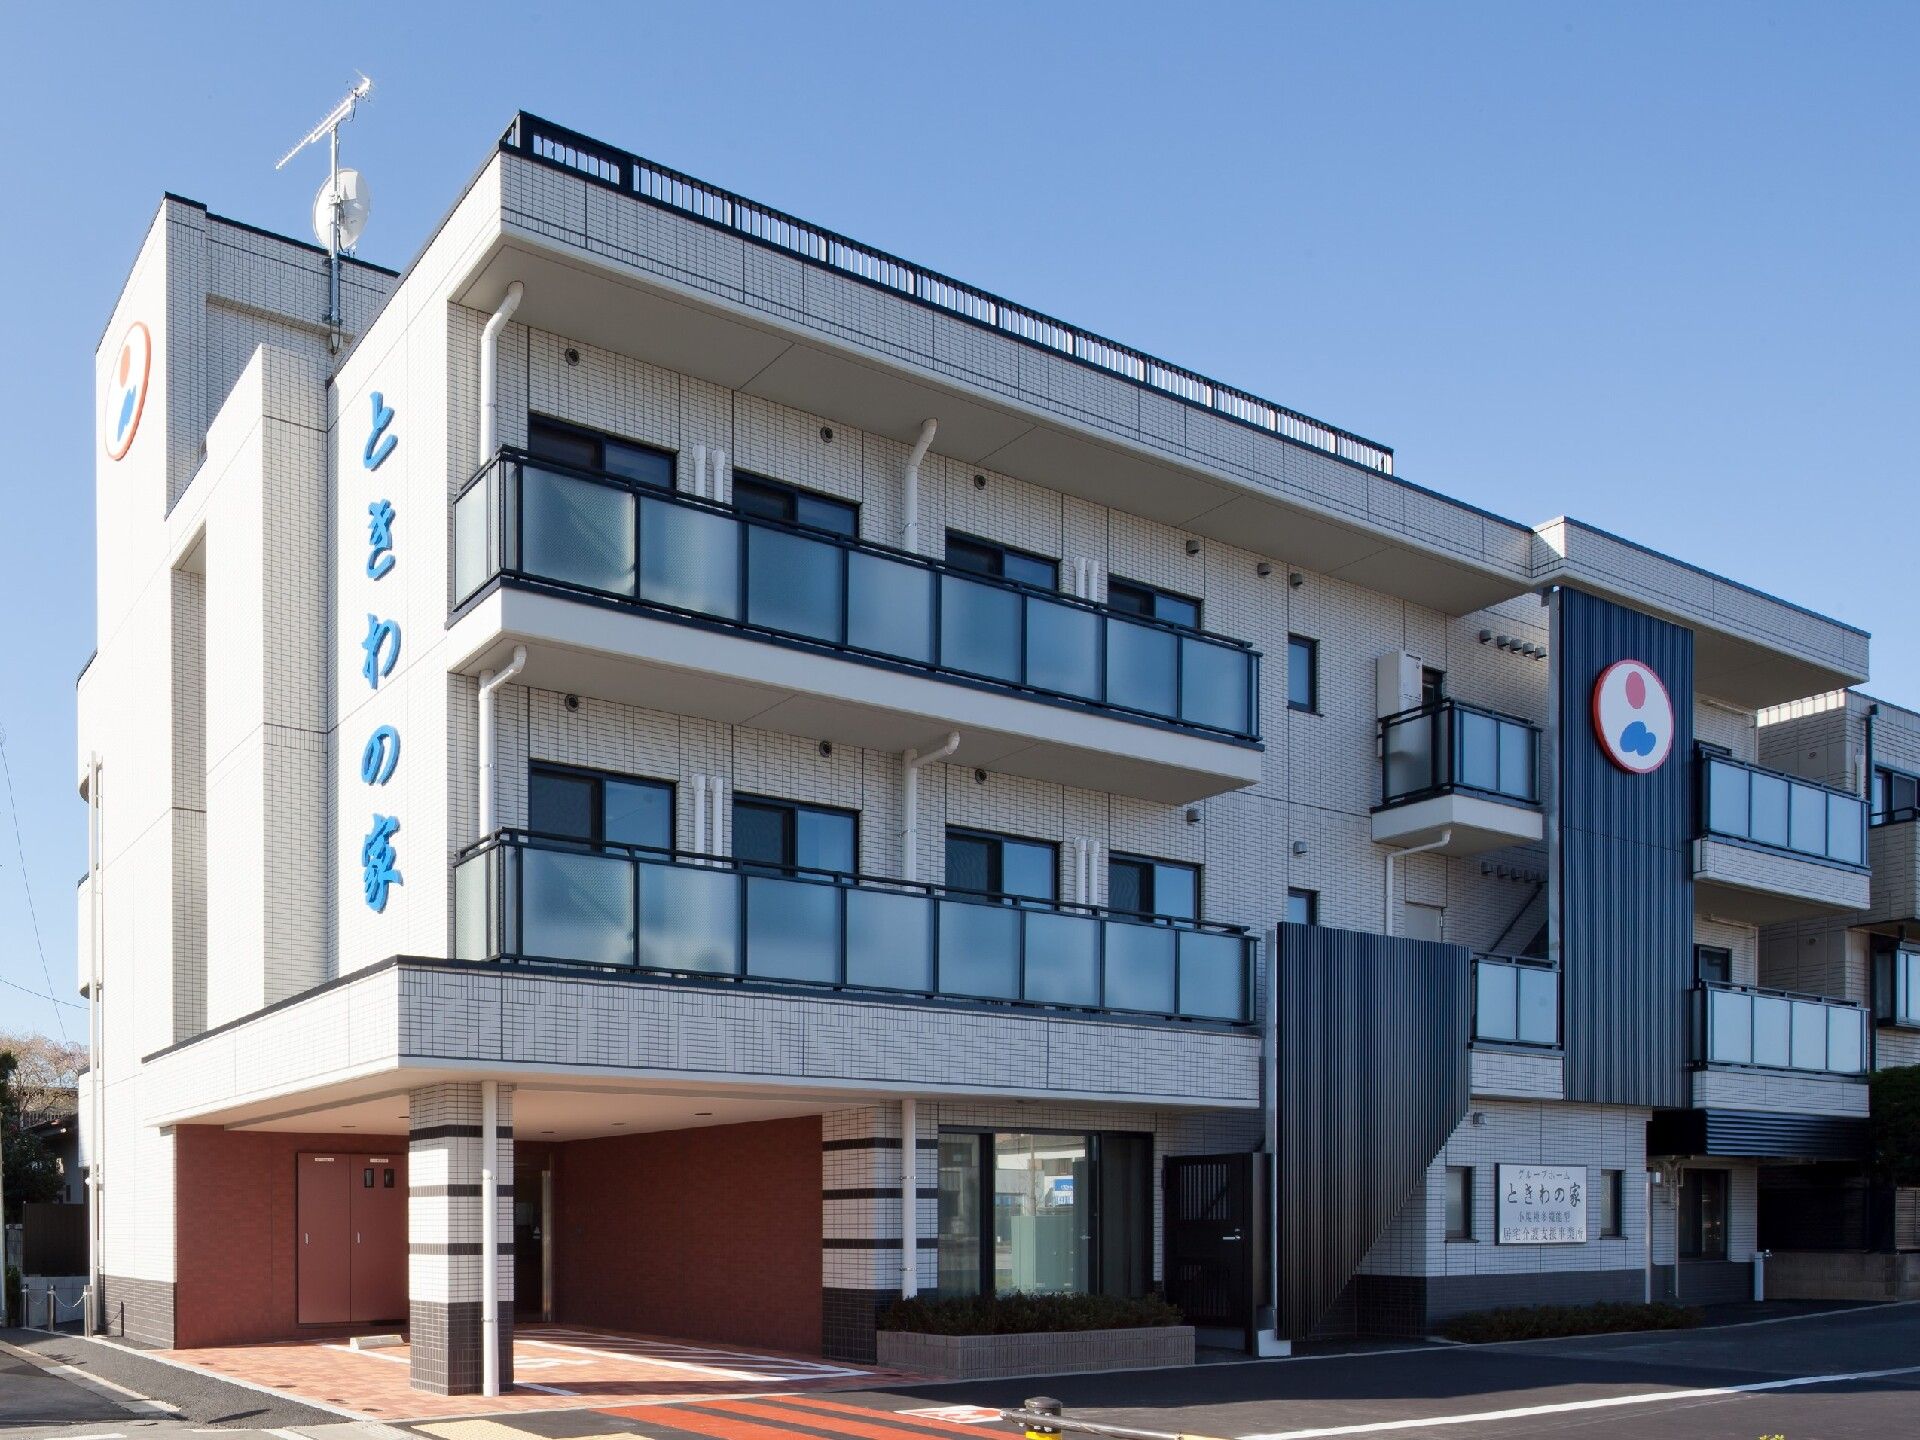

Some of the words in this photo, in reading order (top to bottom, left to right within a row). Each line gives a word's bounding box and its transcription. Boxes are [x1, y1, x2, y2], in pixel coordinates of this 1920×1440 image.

[361, 391, 403, 914] ときわの家
[1518, 1169, 1571, 1180] グループホーム
[1507, 1181, 1581, 1208] ときわの家
[1503, 1226, 1584, 1241] 居宅介護支援事業所
